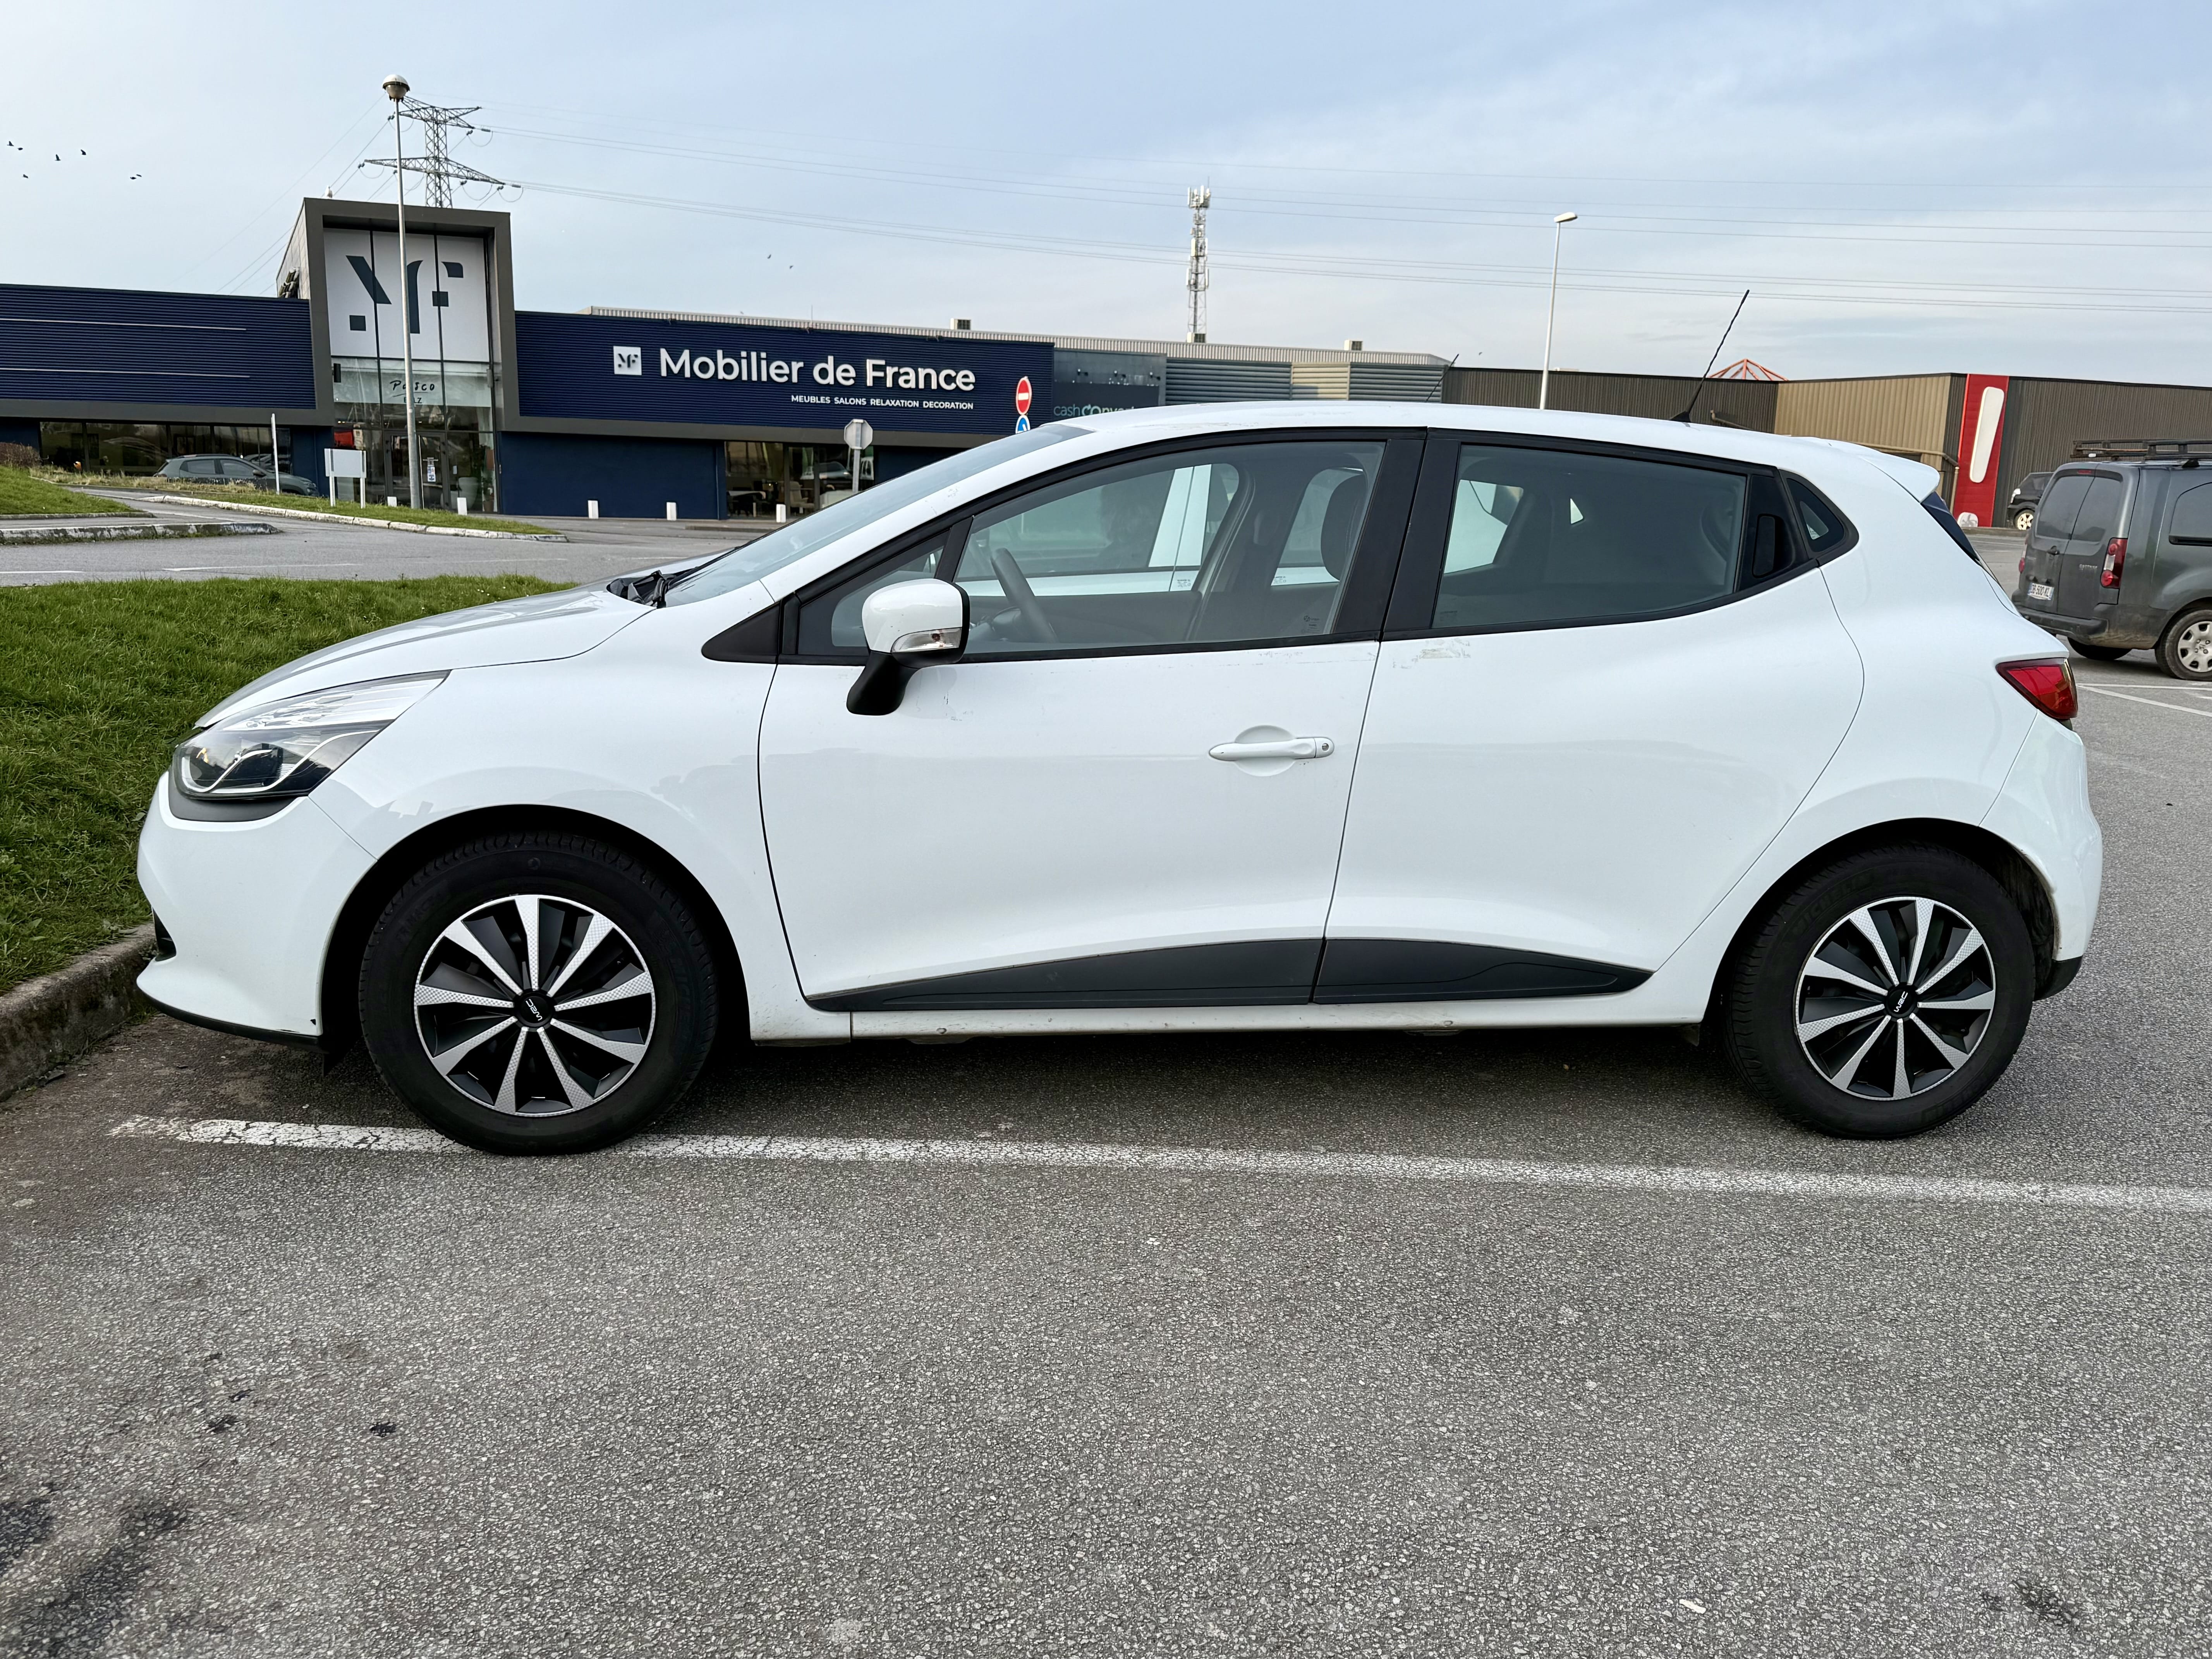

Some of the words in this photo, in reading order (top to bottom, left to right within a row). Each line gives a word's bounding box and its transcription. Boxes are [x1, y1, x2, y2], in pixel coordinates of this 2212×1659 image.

[659, 348, 804, 383] Mobilier
[812, 355, 856, 386] de
[866, 359, 976, 391] France
[791, 395, 831, 404] MEUBLES
[834, 397, 867, 405] SALONS
[870, 398, 919, 407] RELAXATION
[922, 401, 974, 410] DECORATION
[1053, 404, 1080, 416] cash
[526, 998, 543, 1021] WRC
[1893, 991, 1908, 1012] WRC
